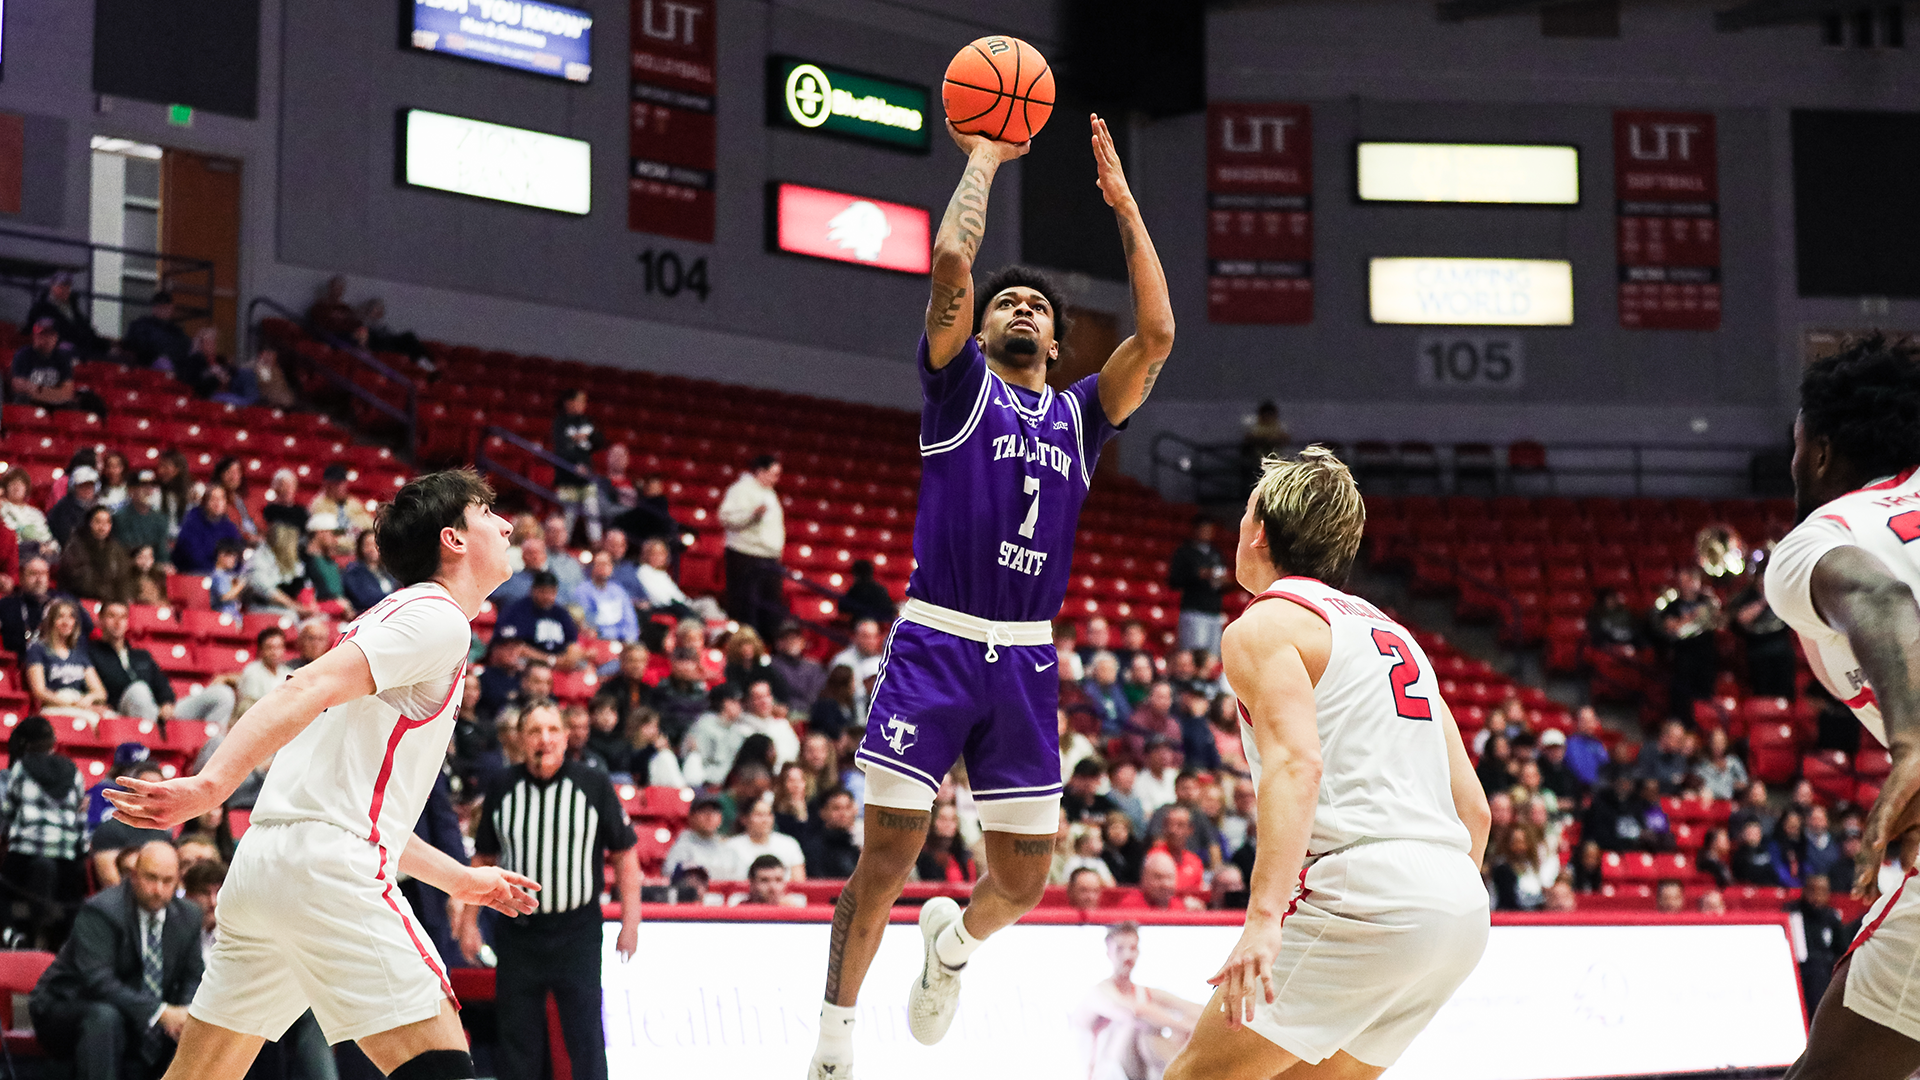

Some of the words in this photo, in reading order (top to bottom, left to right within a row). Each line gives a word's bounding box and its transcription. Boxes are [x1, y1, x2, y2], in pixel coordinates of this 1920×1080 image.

[1223, 116, 1297, 152] UT
[1628, 123, 1701, 161] UT
[636, 249, 711, 302] 104
[1415, 263, 1531, 288] CAMPING
[1415, 290, 1531, 317] WORLD
[1425, 341, 1514, 382] 105
[1018, 475, 1041, 540] 7
[997, 540, 1048, 577] STATE
[1371, 627, 1433, 722] 2
